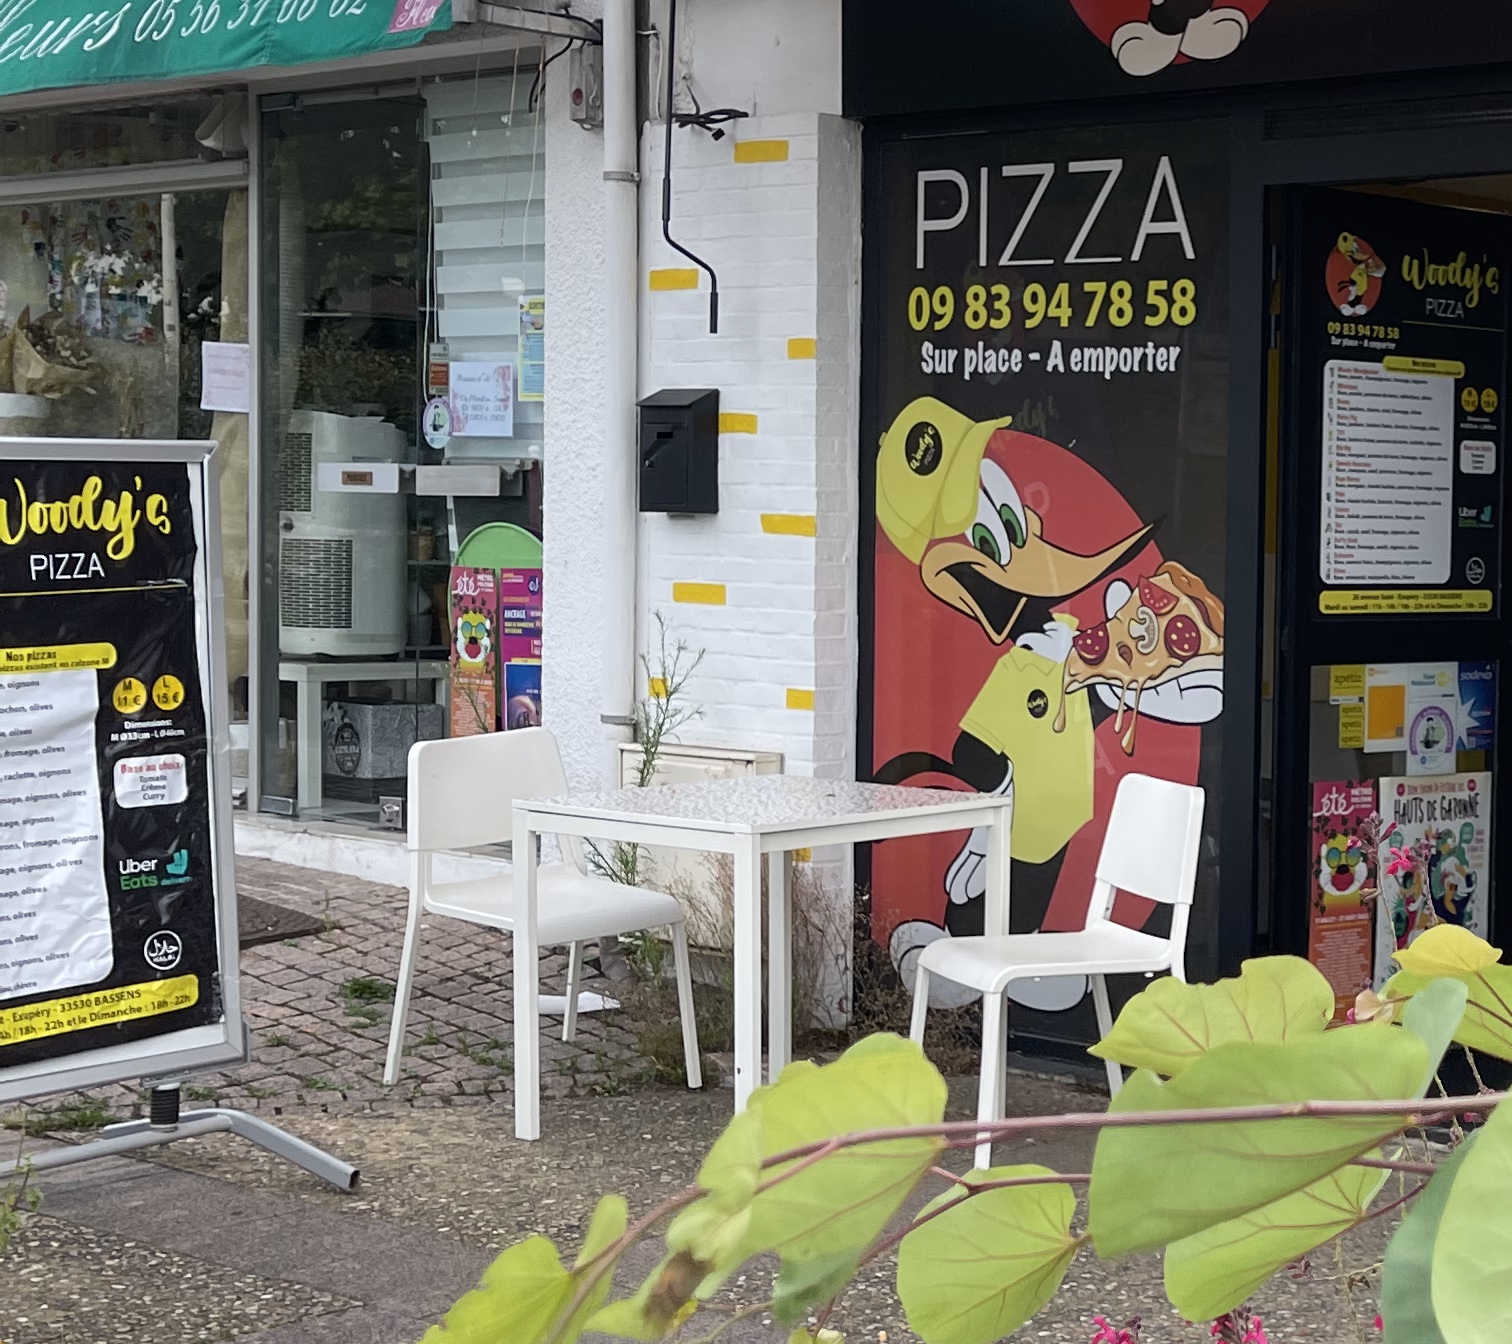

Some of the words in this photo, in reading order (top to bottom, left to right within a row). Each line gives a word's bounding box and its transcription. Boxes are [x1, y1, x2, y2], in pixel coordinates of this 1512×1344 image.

[915, 155, 1196, 270] PIZZA
[1401, 247, 1499, 309] Woody's
[908, 285, 955, 331] 09
[963, 283, 1012, 330] 83
[1022, 281, 1073, 329] 94
[1083, 279, 1134, 328] 78
[1144, 278, 1197, 327] 58
[1425, 297, 1465, 319] PIZZA
[920, 340, 958, 374] Sur
[963, 340, 1023, 381] place
[1046, 339, 1066, 373] A
[1069, 341, 1181, 380] emporter
[30, 552, 105, 581] PIZZA
[122, 680, 133, 691] M
[162, 677, 170, 688] L
[119, 859, 158, 875] Uber
[120, 874, 158, 891] Eats
[44, 1019, 65, 1031] 22h
[89, 1004, 143, 1023] Dimanche
[174, 994, 191, 1006] 22h
[59, 998, 92, 1013] 33530
[94, 989, 142, 1007] BASSENS
